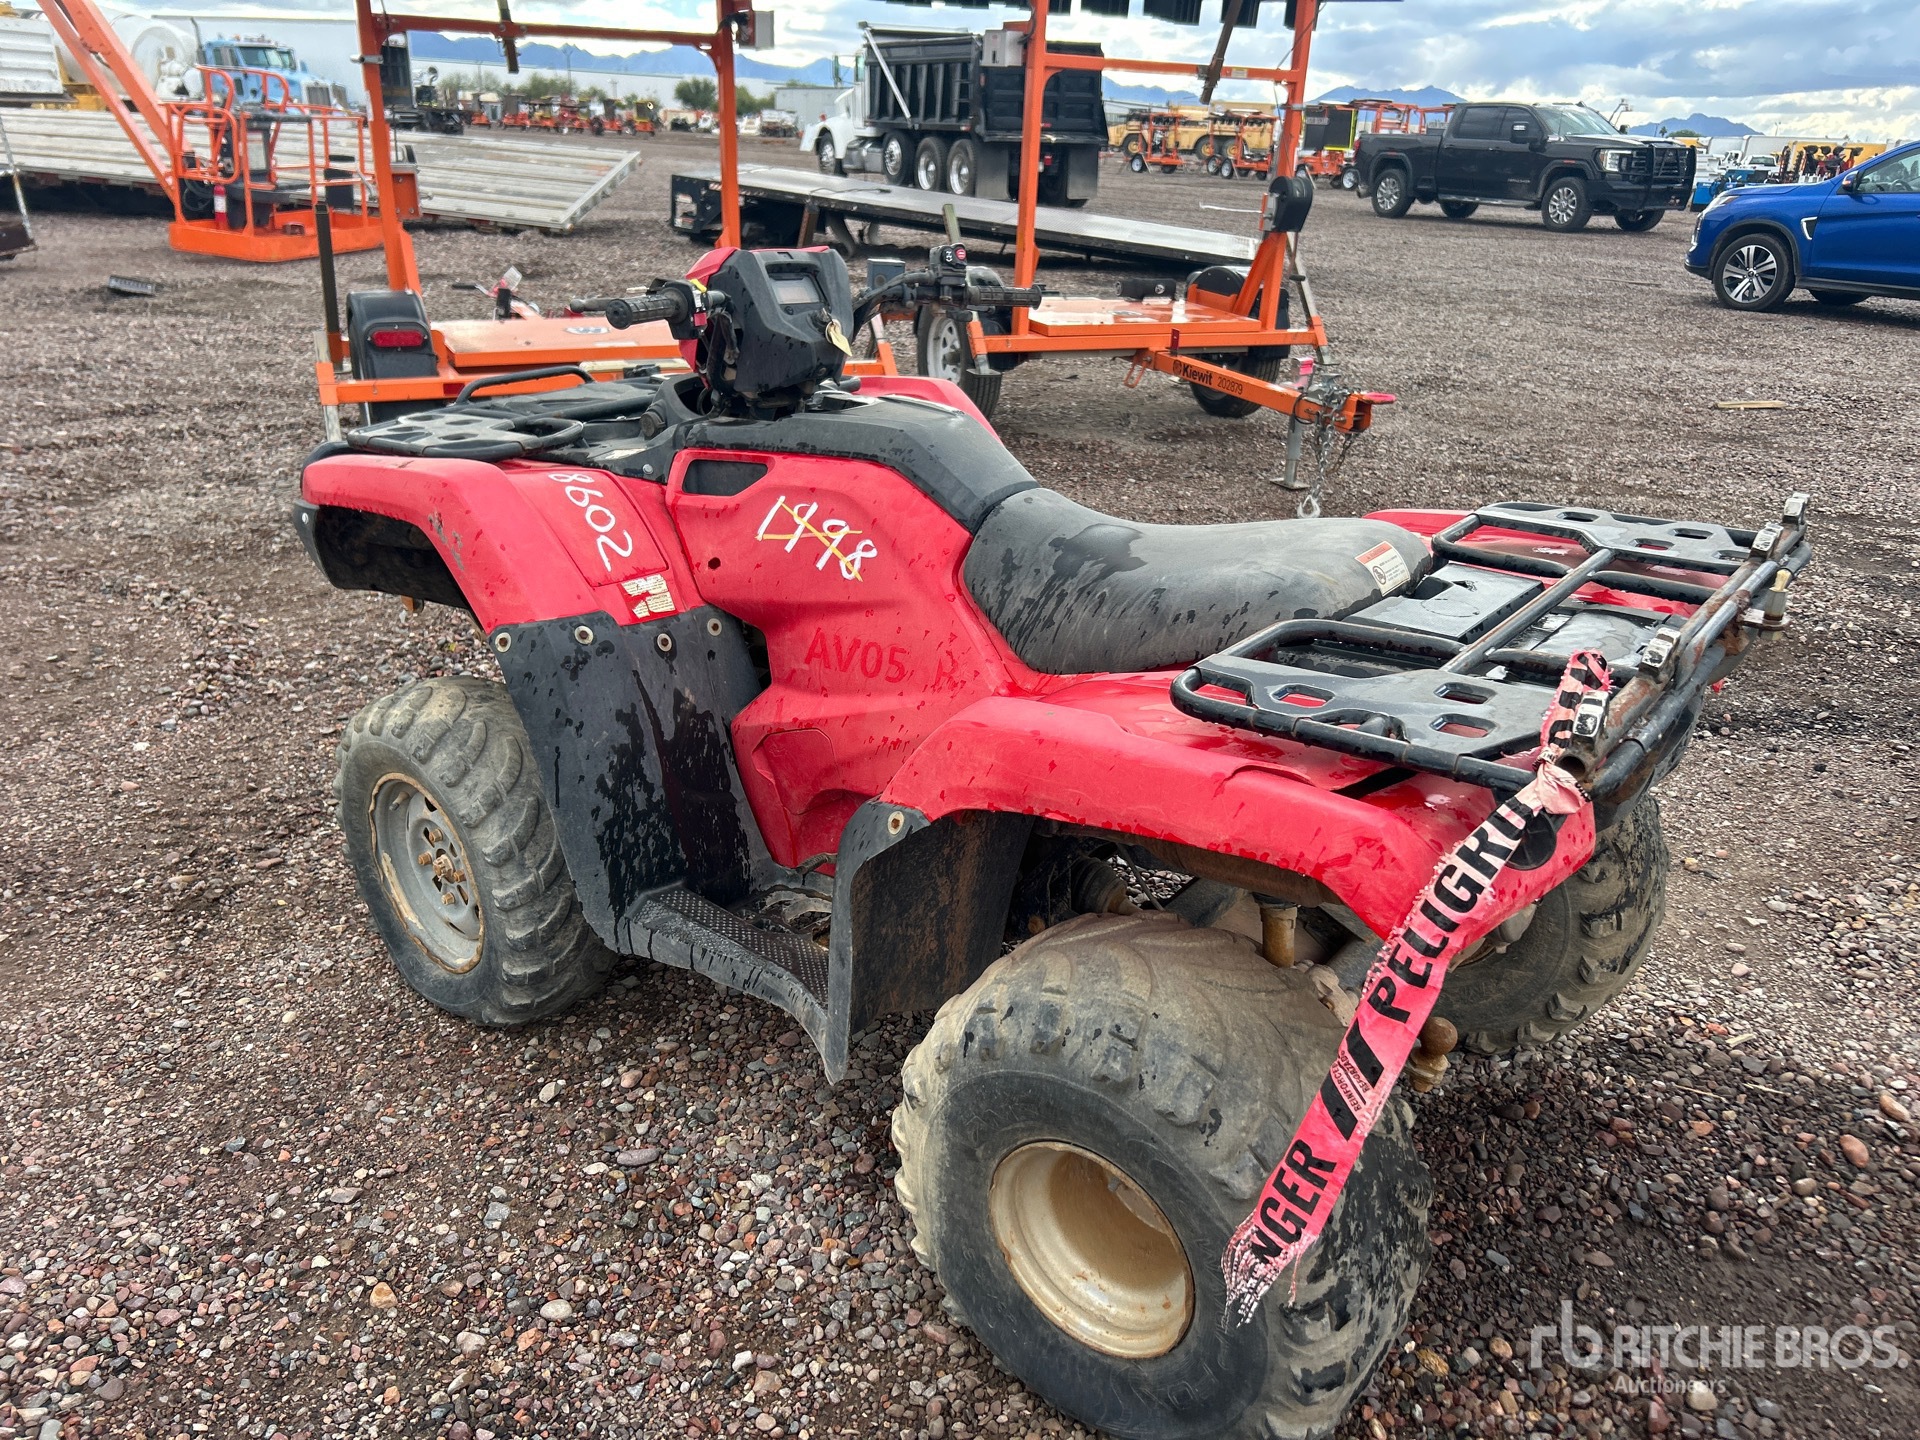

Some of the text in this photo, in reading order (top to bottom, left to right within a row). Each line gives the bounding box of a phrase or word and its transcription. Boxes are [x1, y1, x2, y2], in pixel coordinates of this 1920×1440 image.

[1182, 362, 1244, 396] Kiewit 202879
[547, 472, 633, 572] 8602
[804, 626, 907, 684] AV05
